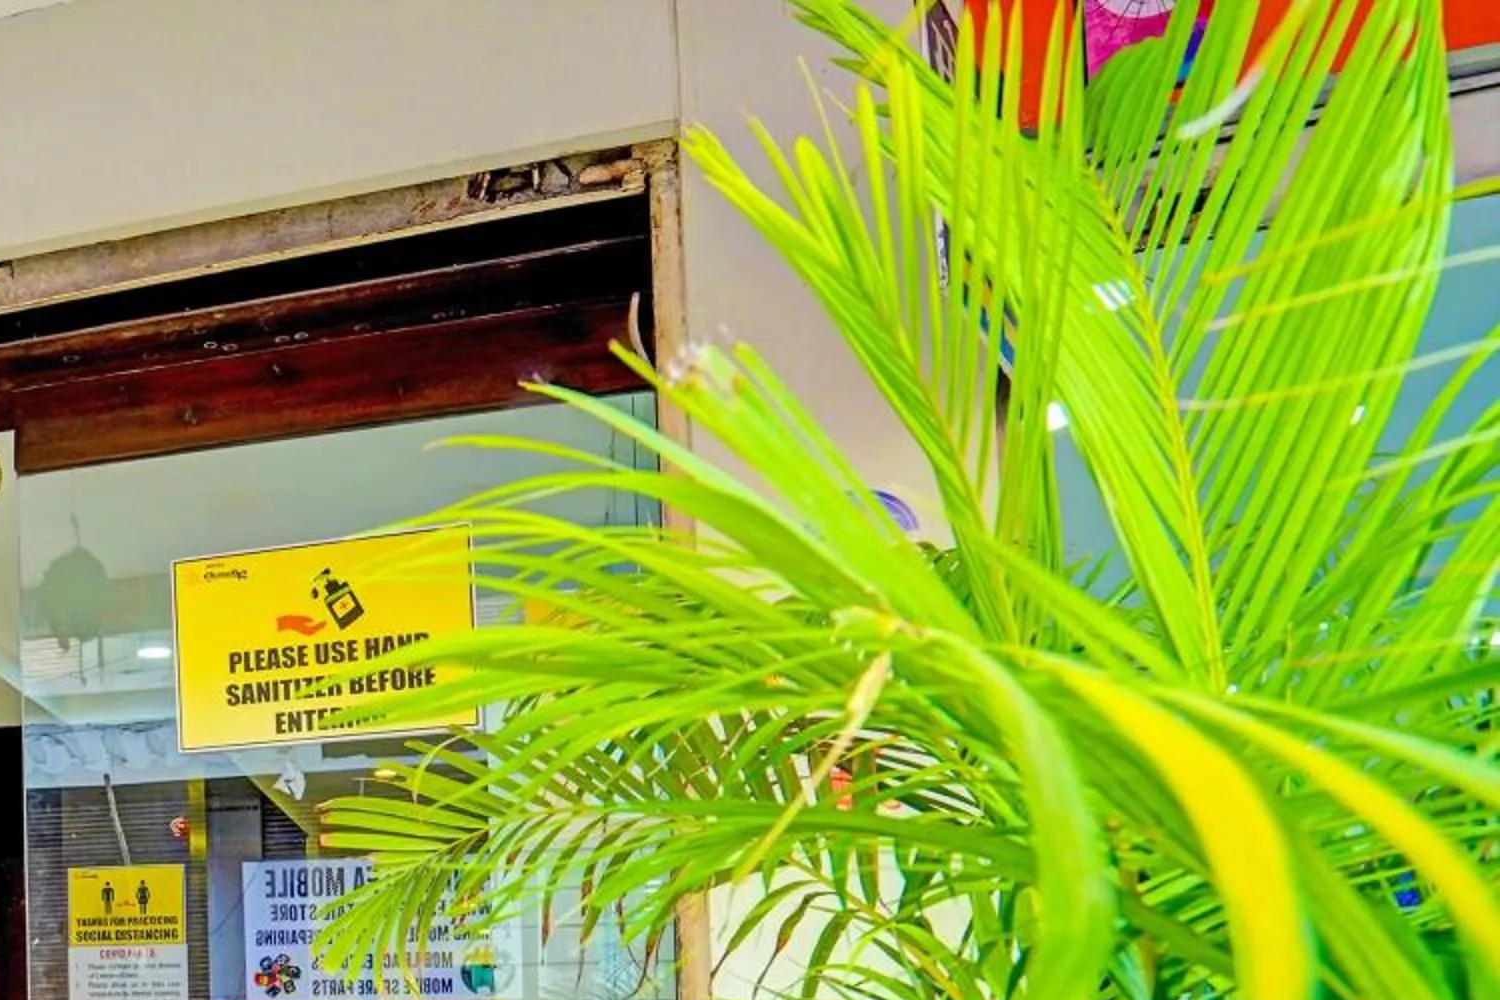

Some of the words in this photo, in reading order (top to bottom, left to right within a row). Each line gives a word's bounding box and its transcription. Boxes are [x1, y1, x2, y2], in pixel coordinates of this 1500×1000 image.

[229, 645, 308, 674] PLEASE
[315, 639, 358, 665] USE
[350, 667, 435, 695] BEFORE
[275, 707, 387, 734] ENTE
[75, 929, 113, 942] SOCIAL
[115, 928, 179, 941] DISTANCING
[109, 917, 126, 926] FOR
